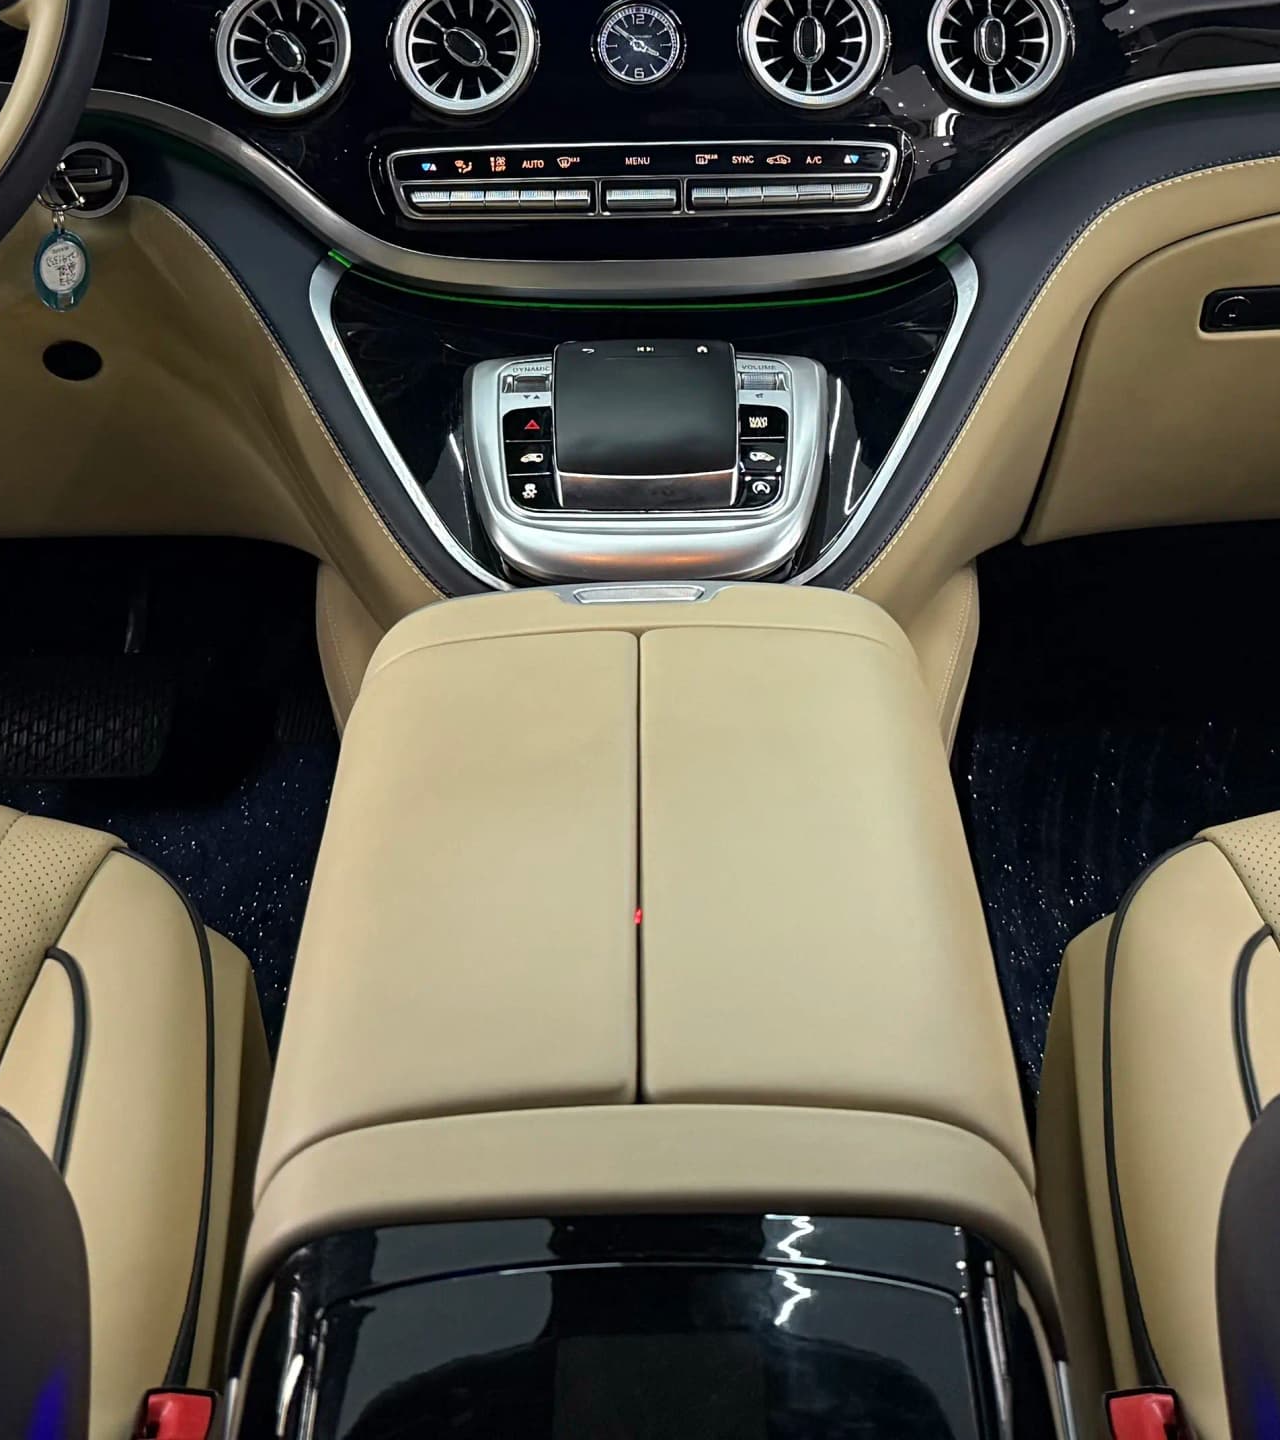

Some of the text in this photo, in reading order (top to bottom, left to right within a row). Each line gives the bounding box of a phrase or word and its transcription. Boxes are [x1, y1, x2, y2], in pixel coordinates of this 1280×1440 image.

[631, 14, 645, 25] 12
[634, 68, 645, 79] 6
[625, 156, 651, 166] MENU
[732, 155, 755, 164] SYNC
[806, 156, 823, 165] A/C
[522, 160, 545, 169] AUTO
[512, 365, 551, 373] DYNAMIC
